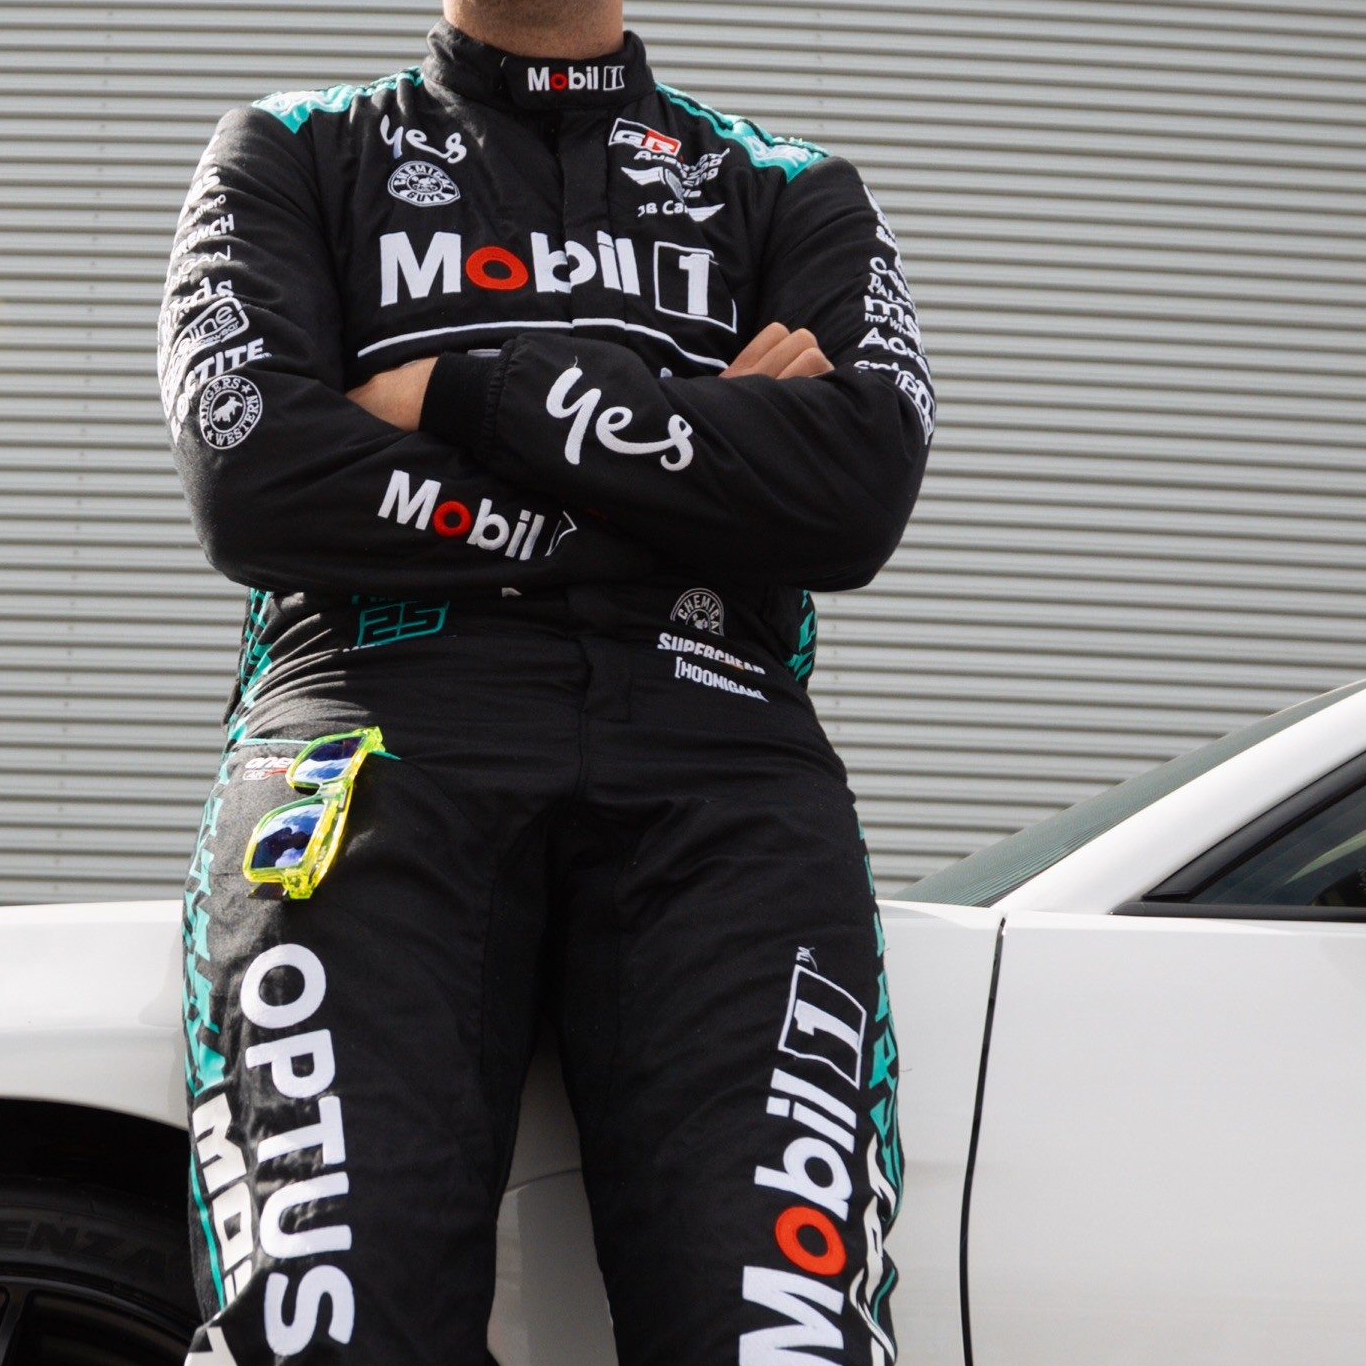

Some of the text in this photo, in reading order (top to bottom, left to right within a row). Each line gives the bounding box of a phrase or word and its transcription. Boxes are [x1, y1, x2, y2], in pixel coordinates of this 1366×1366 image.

[528, 66, 598, 92] Mobil
[380, 115, 467, 164] yes
[380, 230, 640, 308] Mobil
[215, 395, 260, 447] WESTERN
[546, 366, 694, 471] yes
[378, 469, 545, 561] Mobil
[240, 943, 356, 1357] OPTUS
